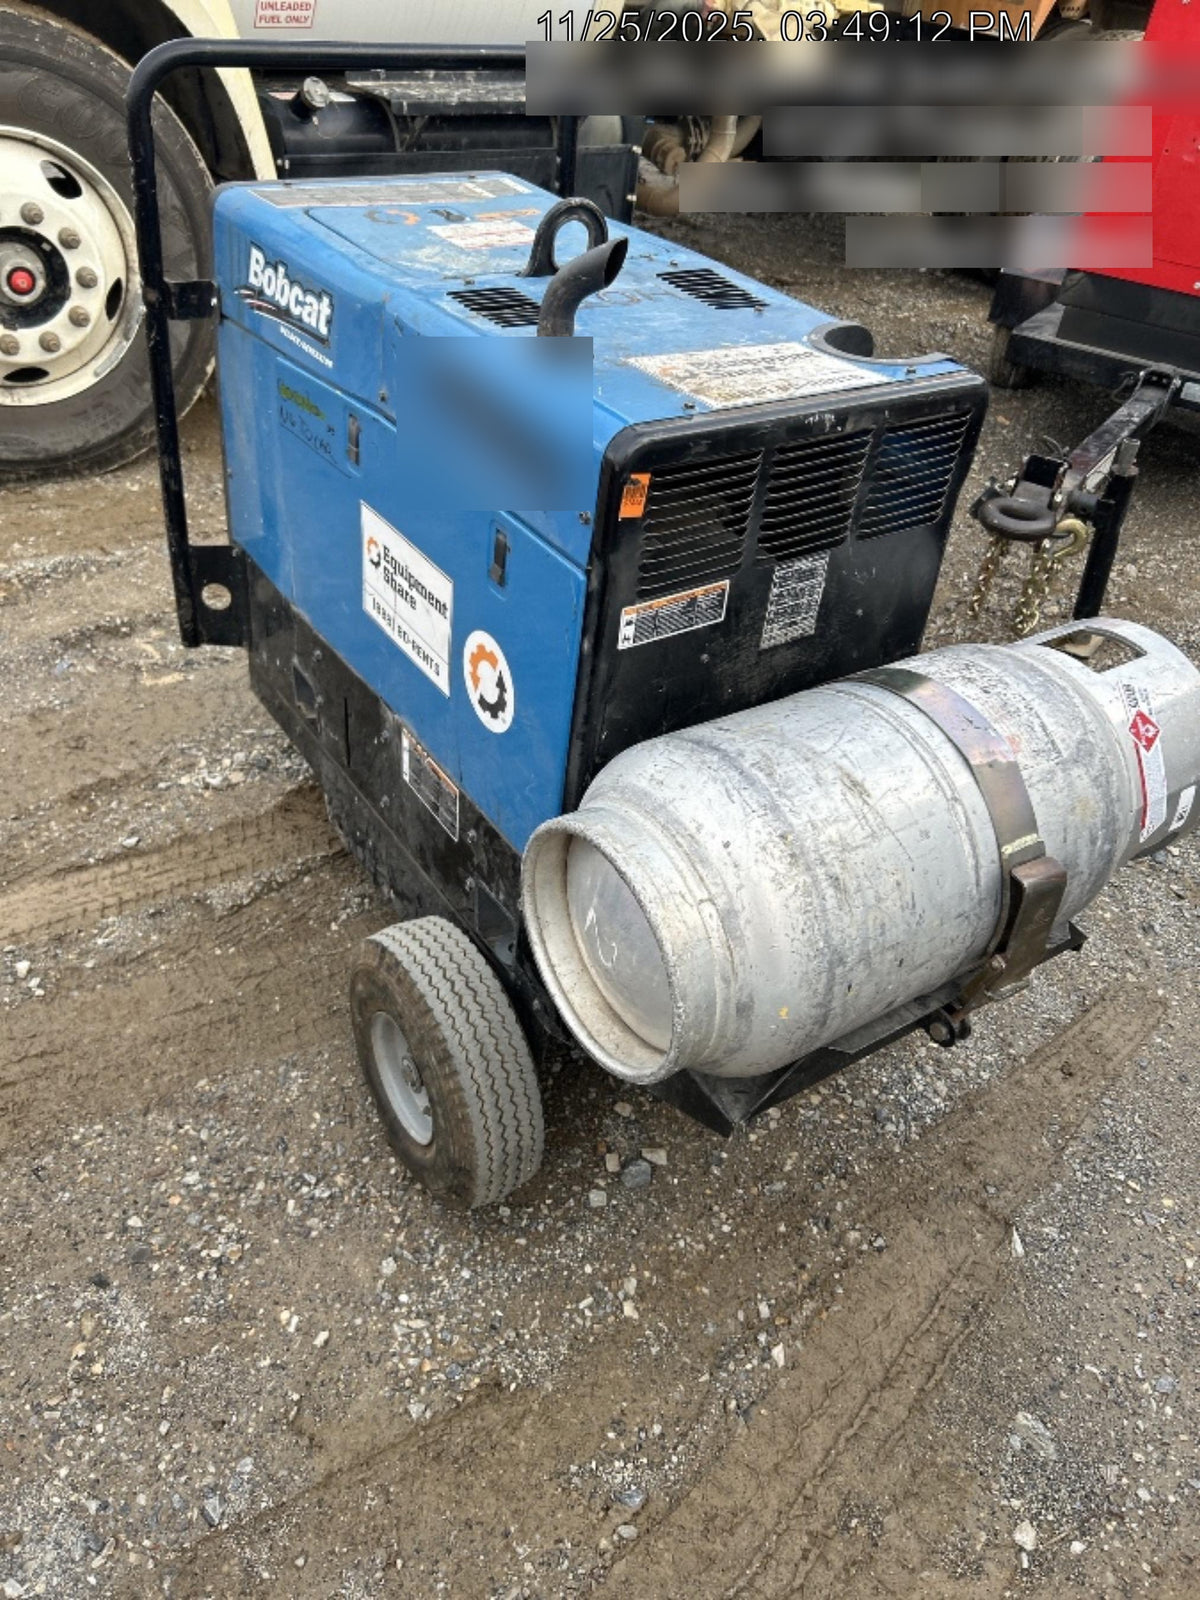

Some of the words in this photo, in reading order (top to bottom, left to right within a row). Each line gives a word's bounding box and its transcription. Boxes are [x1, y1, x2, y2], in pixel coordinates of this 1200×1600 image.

[258, 15, 282, 24] FUEL
[285, 15, 310, 24] ONLY
[260, 1, 312, 12] UNLEADED
[248, 243, 333, 336] Bobcat
[383, 544, 448, 620] Equipment
[383, 565, 417, 611] Share
